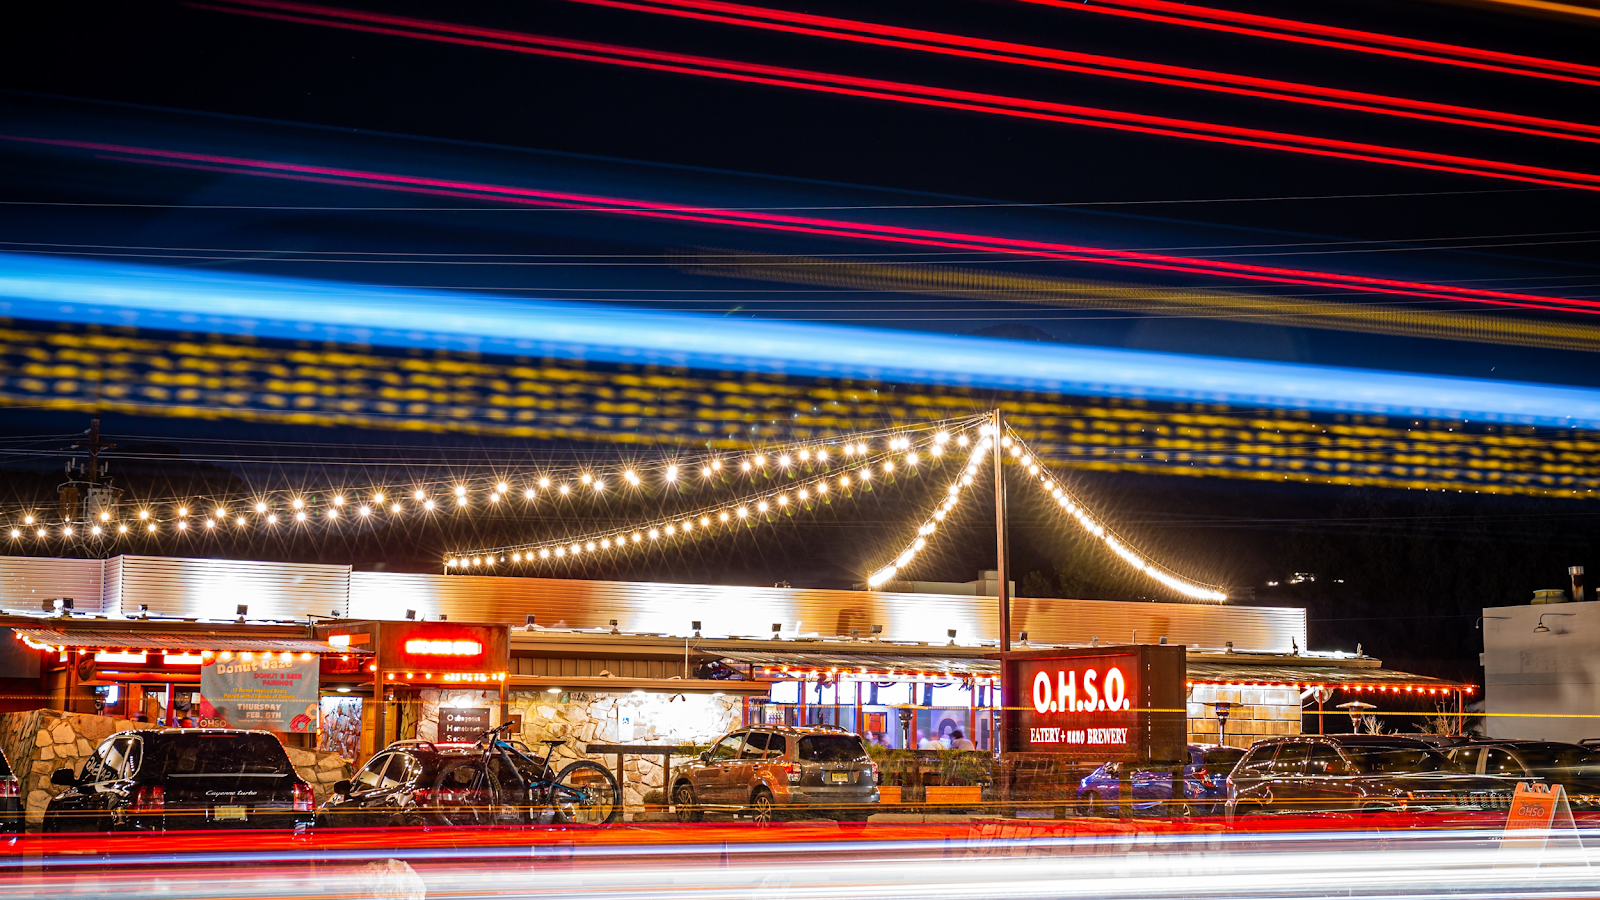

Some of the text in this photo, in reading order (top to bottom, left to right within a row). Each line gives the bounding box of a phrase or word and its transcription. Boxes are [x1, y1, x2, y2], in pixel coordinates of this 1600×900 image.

[216, 659, 293, 675] Donut Daze
[1033, 667, 1130, 713] O.H.S.O.
[237, 703, 282, 711] THURSDAY
[246, 711, 263, 719] FEB.
[199, 719, 227, 728] OHSO
[1030, 727, 1060, 743] EATERY
[1087, 727, 1128, 744] BREWERY
[1518, 806, 1545, 817] OHSO
